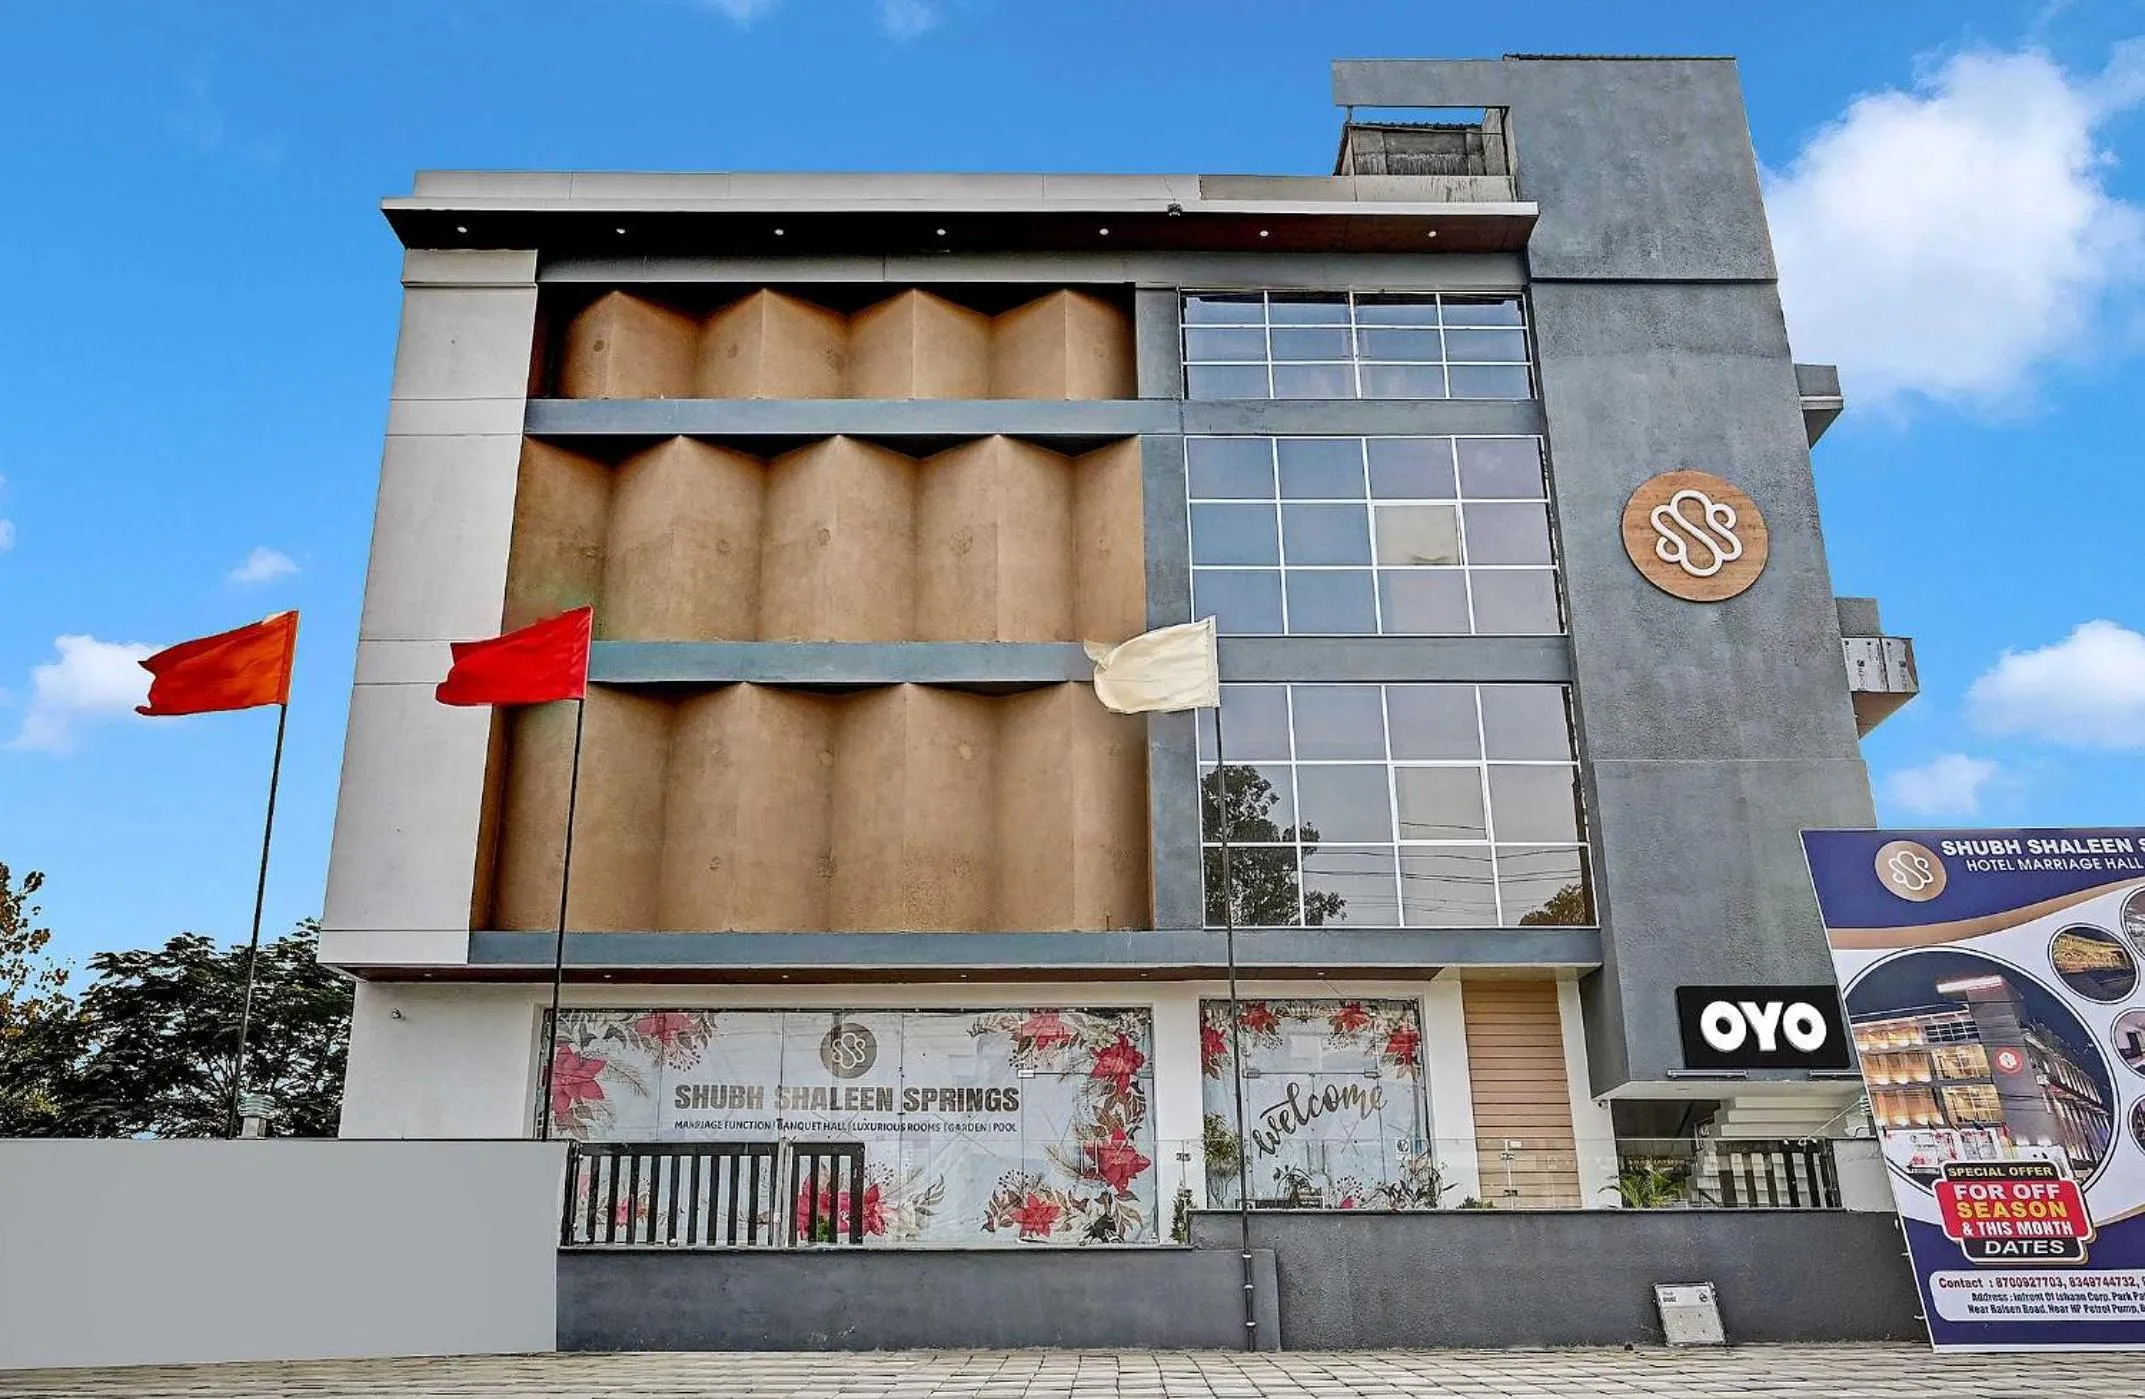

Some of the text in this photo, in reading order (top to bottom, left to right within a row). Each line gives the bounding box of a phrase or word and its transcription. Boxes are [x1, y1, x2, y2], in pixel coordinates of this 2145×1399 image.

[1941, 839, 2023, 856] SHUBH
[2026, 837, 2134, 854] SHALEEN
[1966, 857, 2144, 872] HOTEL MARRIAGE HALL
[1700, 1000, 1827, 1053] OYO
[674, 1084, 1019, 1112] SHUBH SHALEEN SPRINGS
[724, 1120, 771, 1130] FUNCTION
[777, 1120, 821, 1132] BANQUET
[823, 1121, 846, 1131] HALL
[852, 1122, 905, 1132] LUXURIOUS
[907, 1122, 941, 1132] ROOMS
[947, 1122, 986, 1132] GARDEN
[993, 1122, 1017, 1132] POOL
[1252, 1082, 1389, 1159] welcome
[1950, 1166, 2053, 1178] SPECIAL OFFER
[1953, 1184, 2061, 1200] FOR OFF
[1956, 1201, 2068, 1218] SEASON
[1962, 1221, 2073, 1237] & THIS MONTH
[1985, 1240, 2065, 1254] DATES
[1939, 1278, 1983, 1288] Contact
